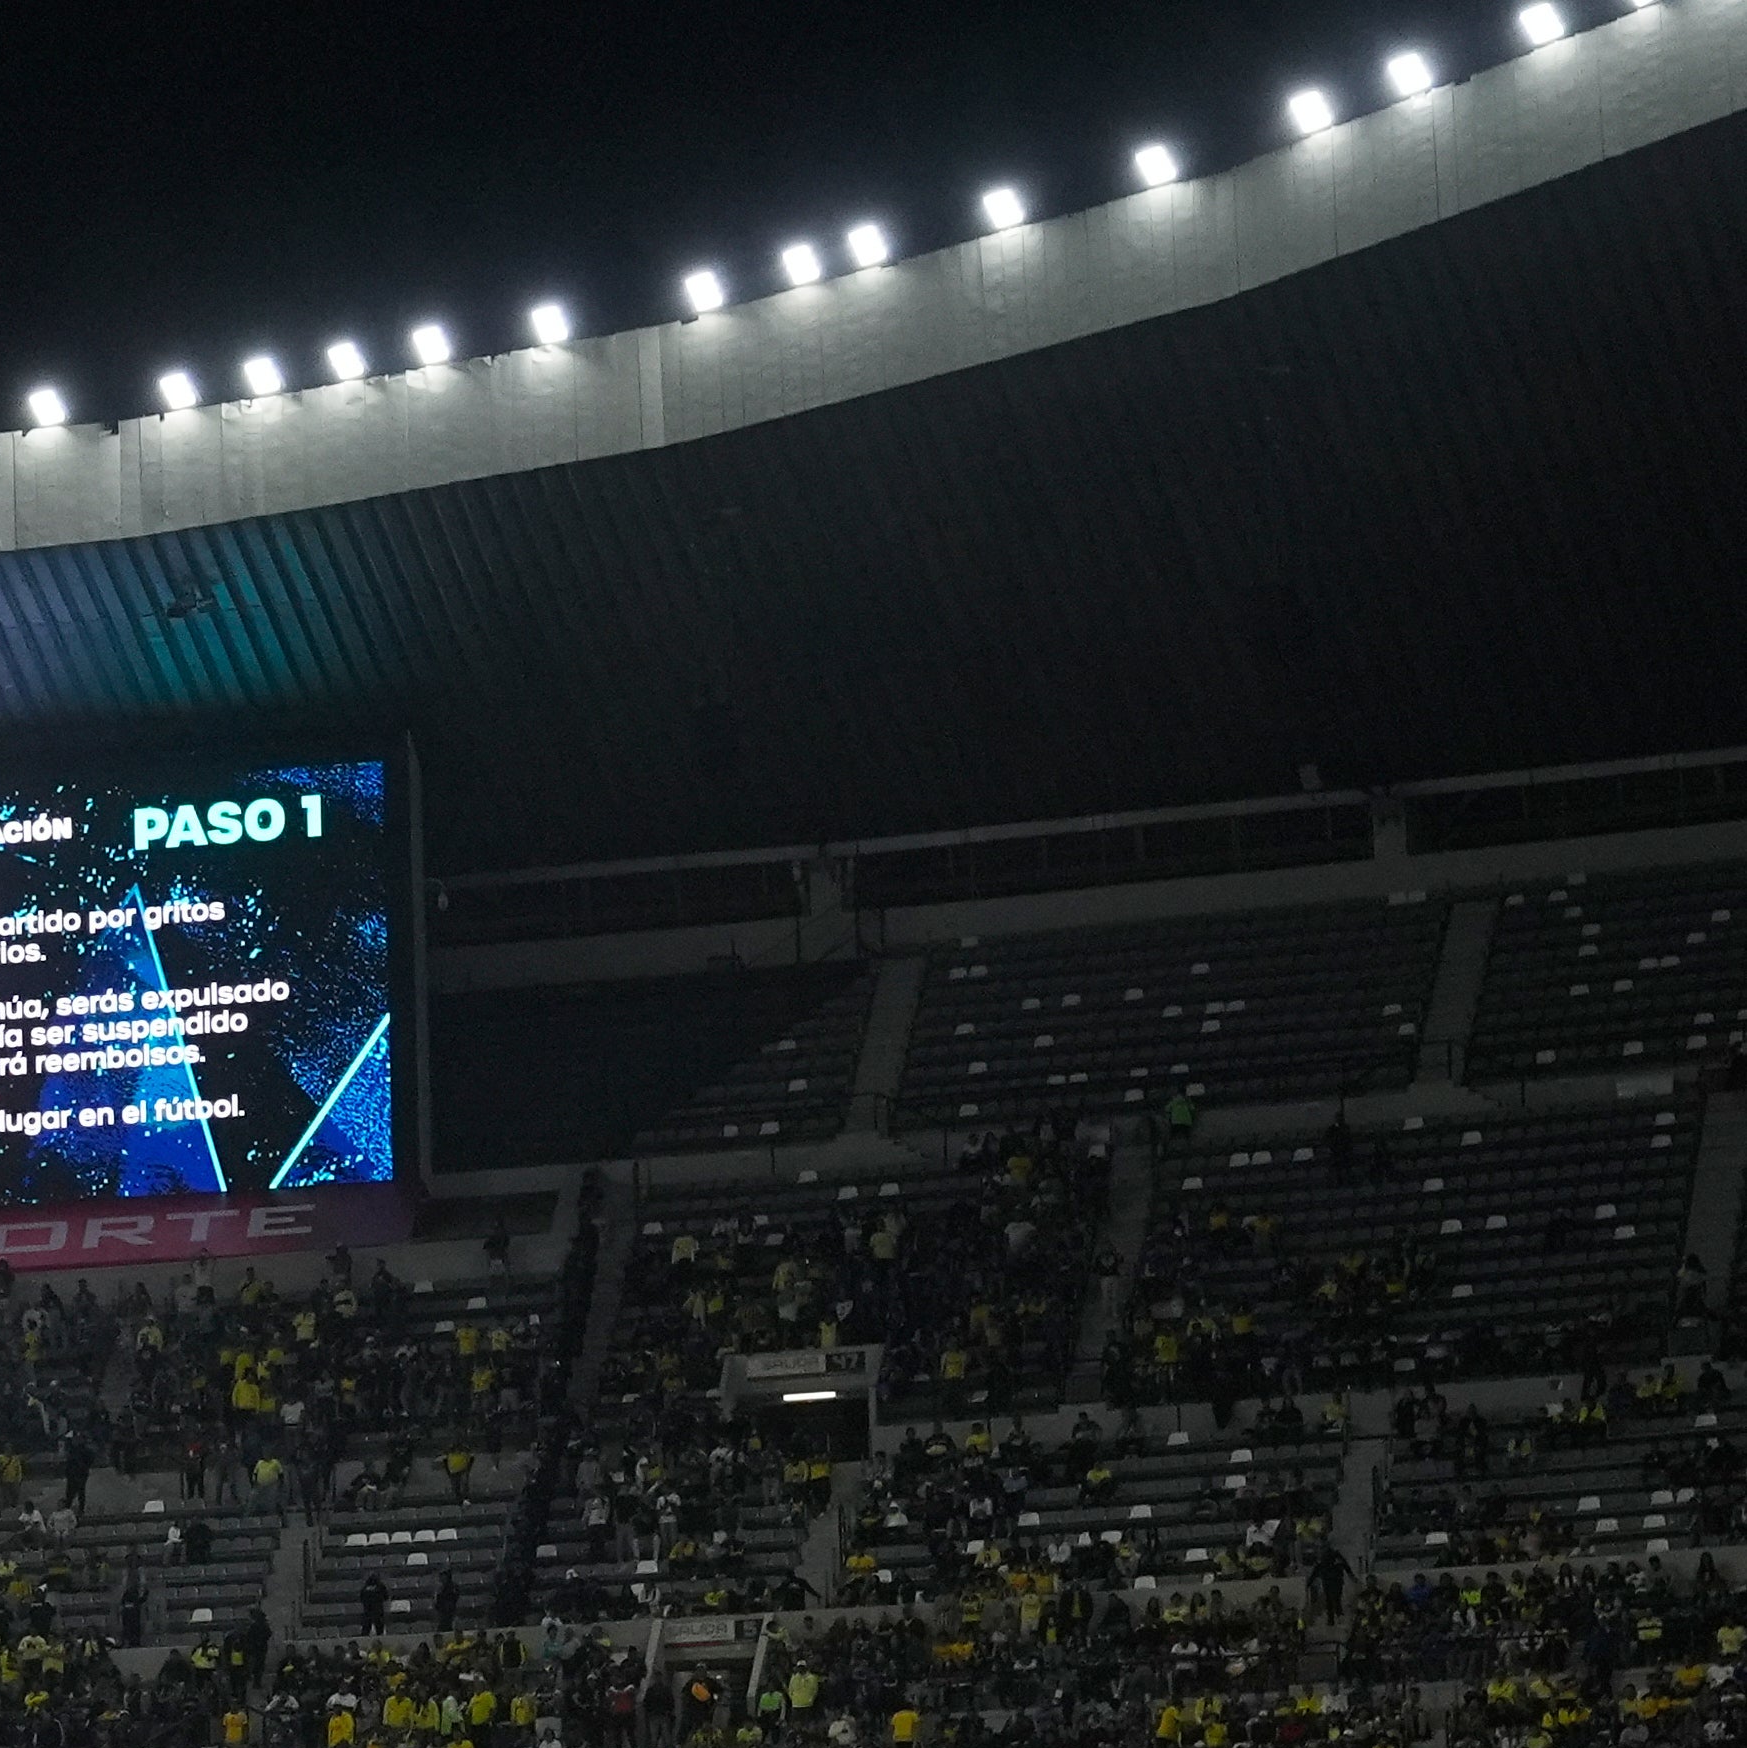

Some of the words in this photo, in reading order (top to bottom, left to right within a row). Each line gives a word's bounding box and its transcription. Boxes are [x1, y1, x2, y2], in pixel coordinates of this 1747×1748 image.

[133, 797, 286, 850] PASO
[299, 793, 323, 838] 1
[88, 907, 138, 934] por
[143, 899, 226, 932] gritos
[54, 987, 135, 1017] serás
[142, 977, 291, 1018] expulsado
[30, 1023, 77, 1047] ser
[81, 1009, 249, 1044] suspendido
[34, 1043, 207, 1075] reembolsos.
[78, 1105, 115, 1127] en
[121, 1100, 148, 1125] el
[153, 1093, 247, 1122] fútbol.
